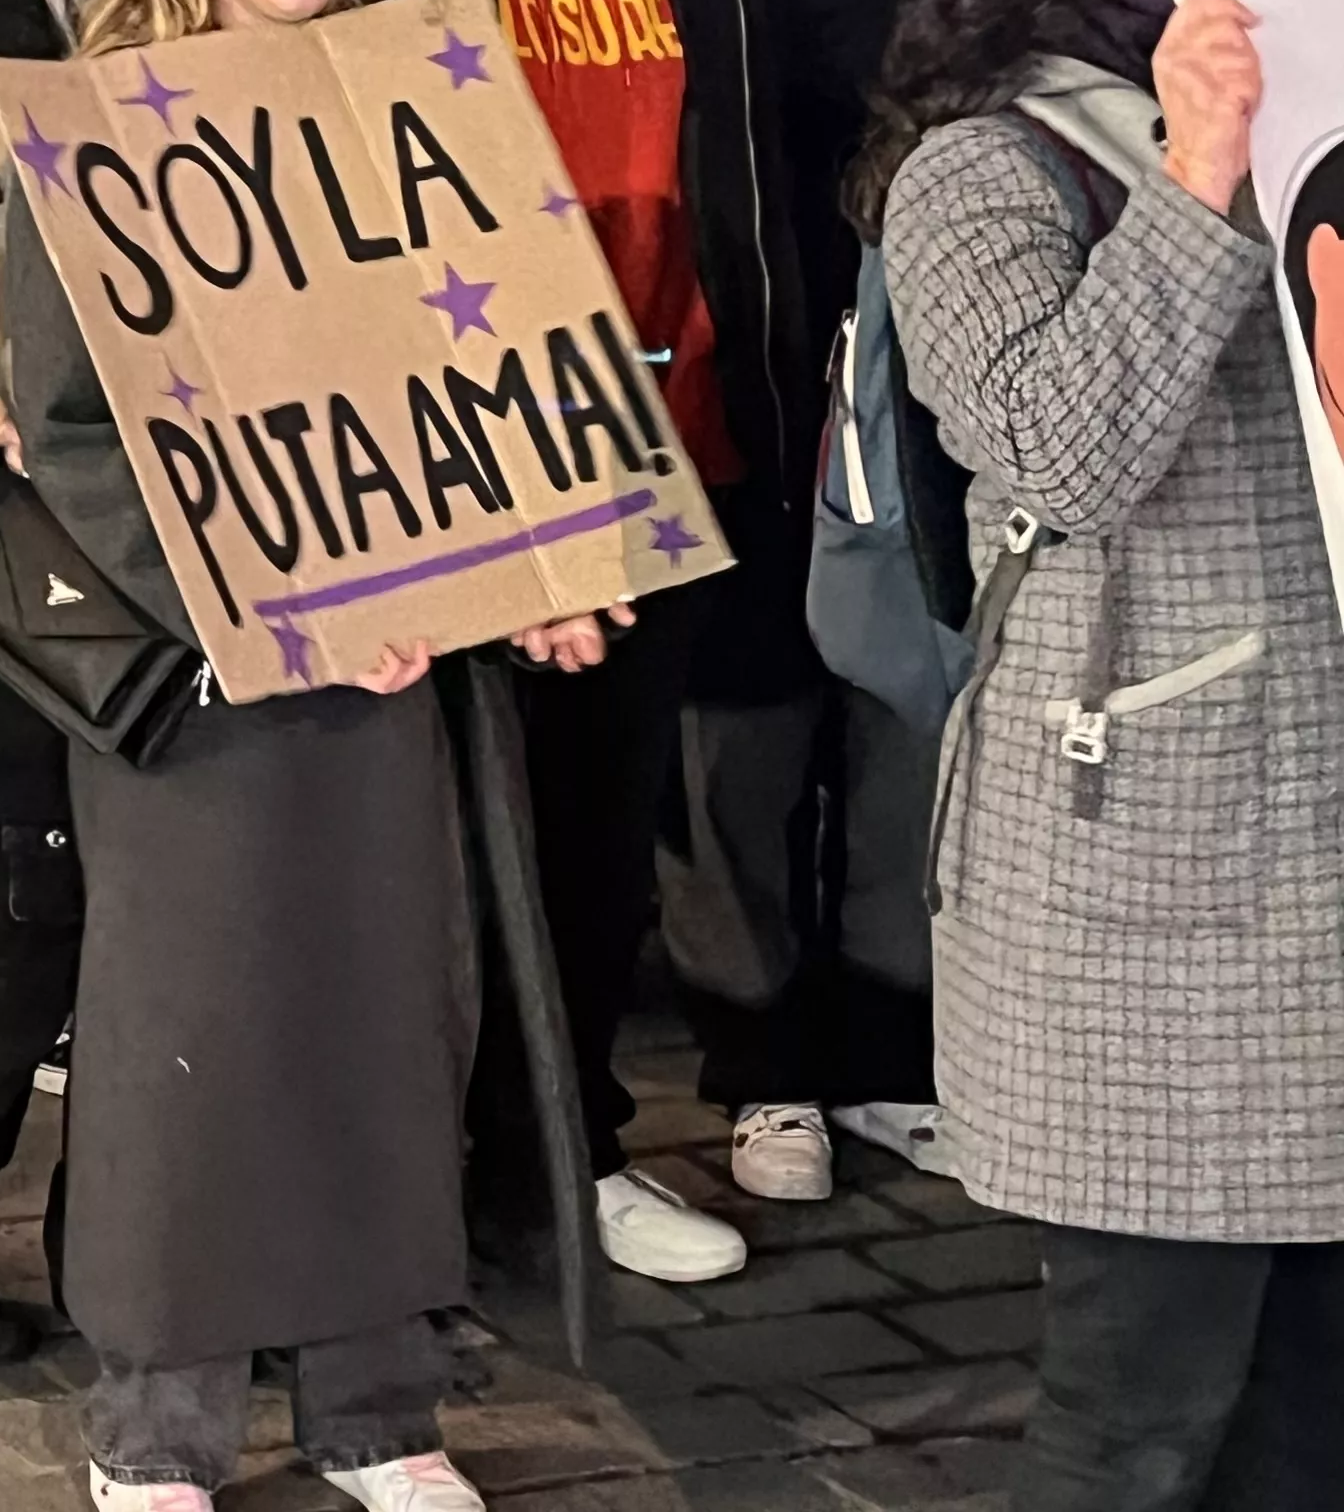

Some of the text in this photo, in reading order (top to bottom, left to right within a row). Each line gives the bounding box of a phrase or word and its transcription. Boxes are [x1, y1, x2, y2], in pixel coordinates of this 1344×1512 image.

[75, 100, 498, 336] SOY LA
[147, 310, 677, 629] PUTA AMA!
